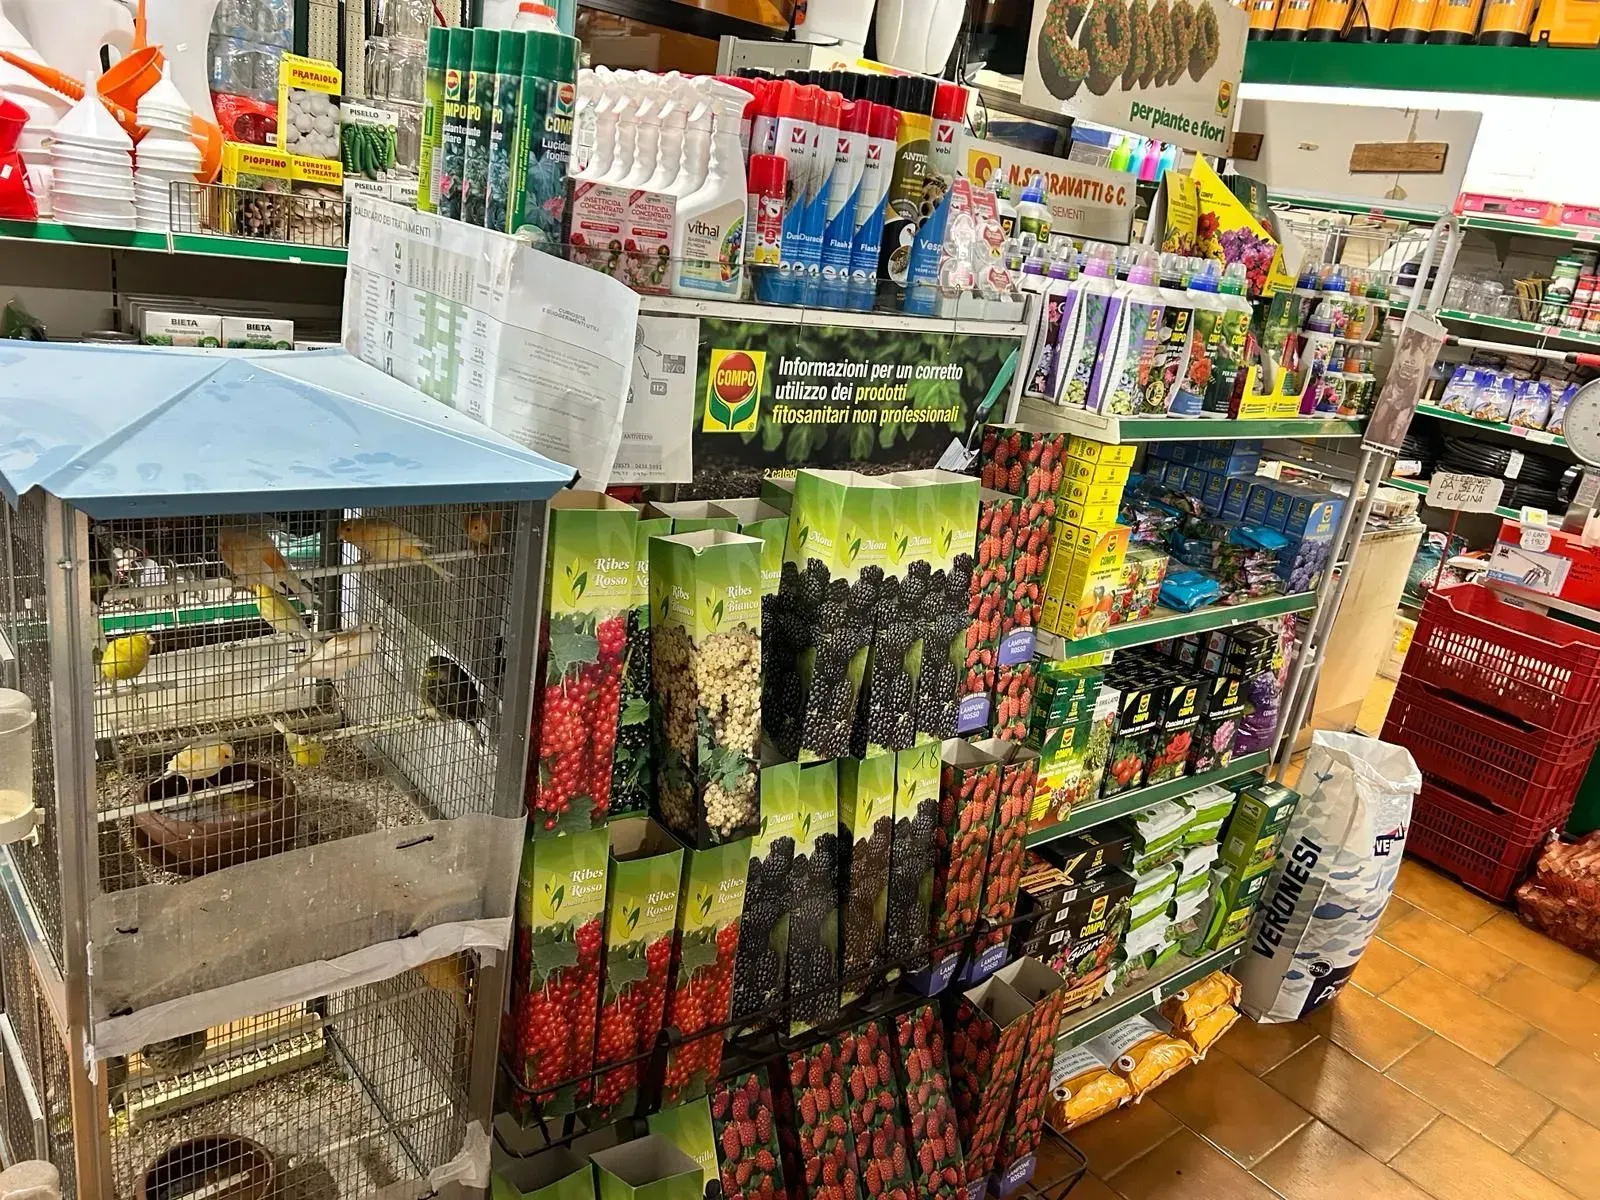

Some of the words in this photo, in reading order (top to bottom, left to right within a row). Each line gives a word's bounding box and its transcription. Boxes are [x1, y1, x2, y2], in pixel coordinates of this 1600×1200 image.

[292, 69, 338, 84] PRATAIOLO
[350, 108, 379, 118] PISELLO
[1129, 101, 1153, 121] per
[1151, 107, 1189, 133] piante
[1191, 121, 1199, 133] e
[1199, 120, 1225, 143] fiori
[936, 147, 951, 155] vebi
[243, 154, 287, 169] PIOPPINO
[294, 160, 332, 171] PLEUROTUS
[302, 168, 340, 179] OSTREATUS
[354, 182, 383, 192] PISELLO
[584, 197, 621, 207] INSETTICIDA
[1104, 184, 1115, 203] &
[1115, 186, 1127, 206] C.
[580, 202, 624, 214] CONCENTRATO
[632, 209, 672, 220] CONCENTRATO
[635, 203, 669, 213] INSETTICIDA
[1051, 205, 1085, 221] SEMENTI
[830, 239, 847, 248] Flash
[861, 244, 877, 252] Flash
[170, 318, 198, 328] BIETA
[246, 323, 272, 333] BIETA
[778, 356, 869, 378] Informazioni
[870, 363, 894, 382] per
[896, 364, 913, 378] un
[915, 363, 963, 380] corretto
[717, 369, 756, 387] COMPO
[775, 382, 828, 400] utilizzo
[831, 382, 853, 400] dei
[855, 383, 908, 404] prodotti
[772, 405, 850, 423] fitosanitari
[852, 409, 877, 423] non
[880, 406, 959, 426] professionali
[763, 468, 770, 479] 2
[1440, 479, 1454, 490] DA
[1459, 483, 1488, 495] SEME
[1437, 491, 1441, 499] E
[1447, 493, 1483, 503] CUCINA
[594, 557, 630, 570] Ribes
[595, 573, 628, 588] Rosso
[672, 585, 690, 600] Ribes
[727, 585, 753, 598] Ribes
[727, 600, 759, 613] Bianco
[1007, 637, 1031, 647] LAMPONE
[1010, 645, 1027, 654] ROSSO
[960, 703, 984, 714] LAMPONE
[963, 711, 980, 720] ROSSO
[912, 744, 939, 769] 18
[570, 868, 604, 884] Ribes
[571, 884, 603, 898] Rosso
[719, 878, 745, 892] Ribes
[647, 890, 677, 904] Ribes
[718, 890, 744, 904] Rosso
[1252, 836, 1322, 959] VERONESI
[646, 904, 674, 918] Rosso
[1079, 921, 1106, 938] COMPO
[1066, 936, 1107, 963] Guano
[980, 952, 1003, 968] LAMPONE
[983, 960, 999, 973] ROSSO
[1007, 1159, 1030, 1178] LAMPONE
[1010, 1169, 1027, 1184] ROSSO
